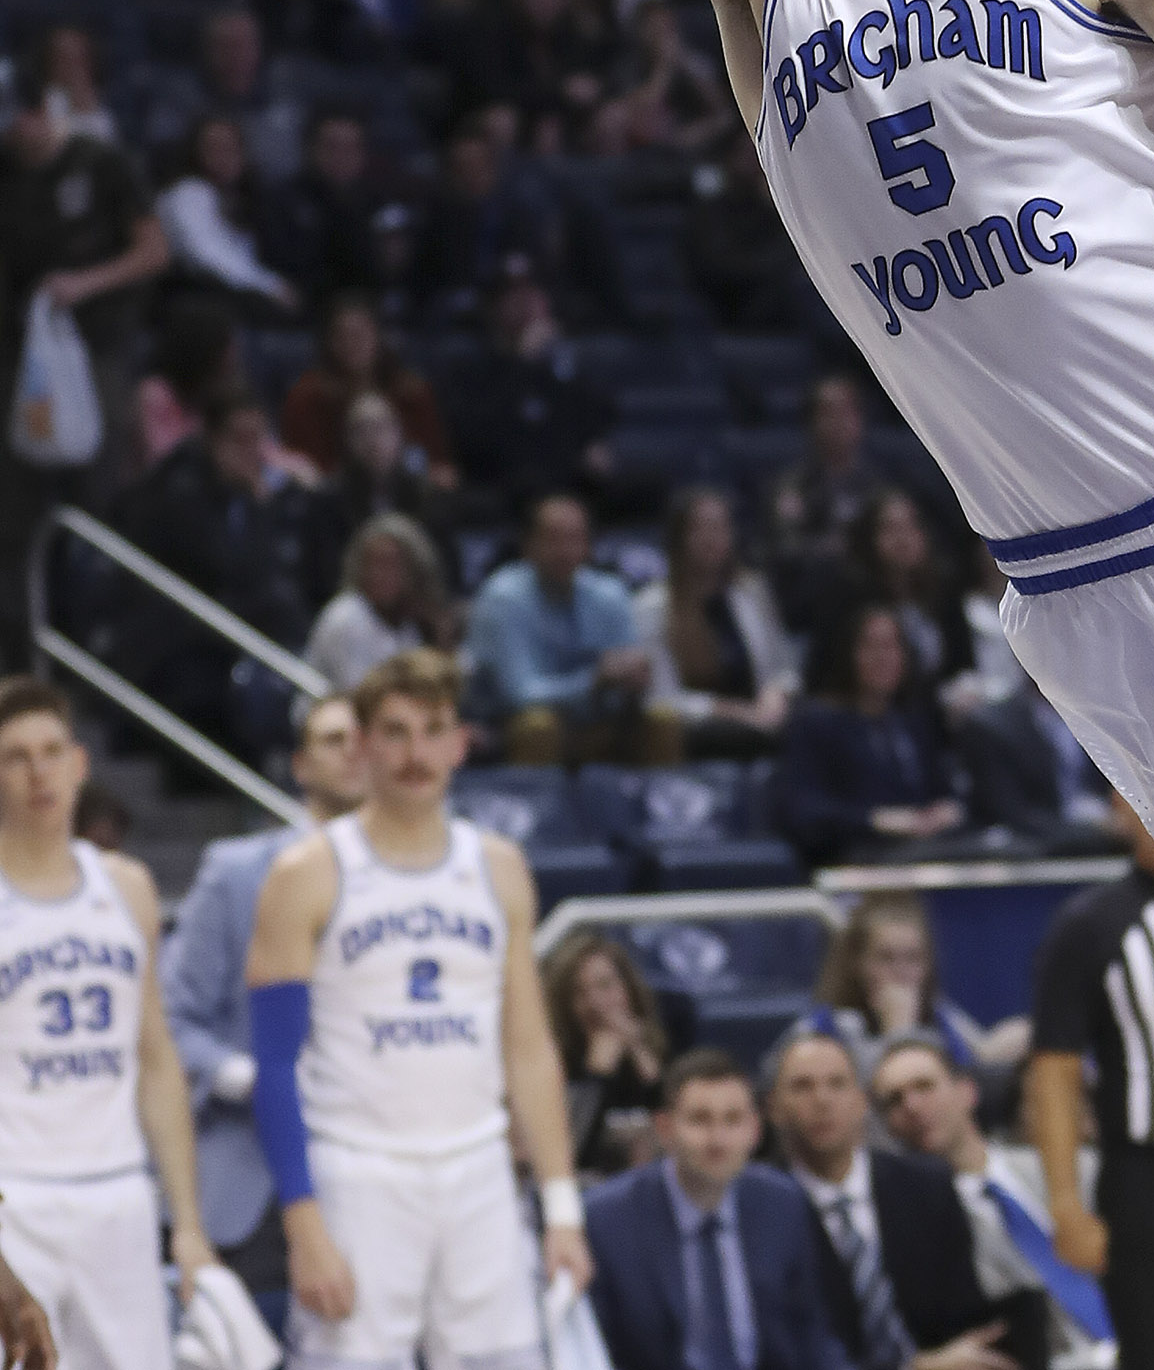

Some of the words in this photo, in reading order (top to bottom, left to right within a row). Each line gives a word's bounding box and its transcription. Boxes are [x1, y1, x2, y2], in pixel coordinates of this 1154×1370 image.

[866, 101, 956, 217] 5
[409, 958, 442, 1003] 2
[38, 984, 113, 1036] 33
